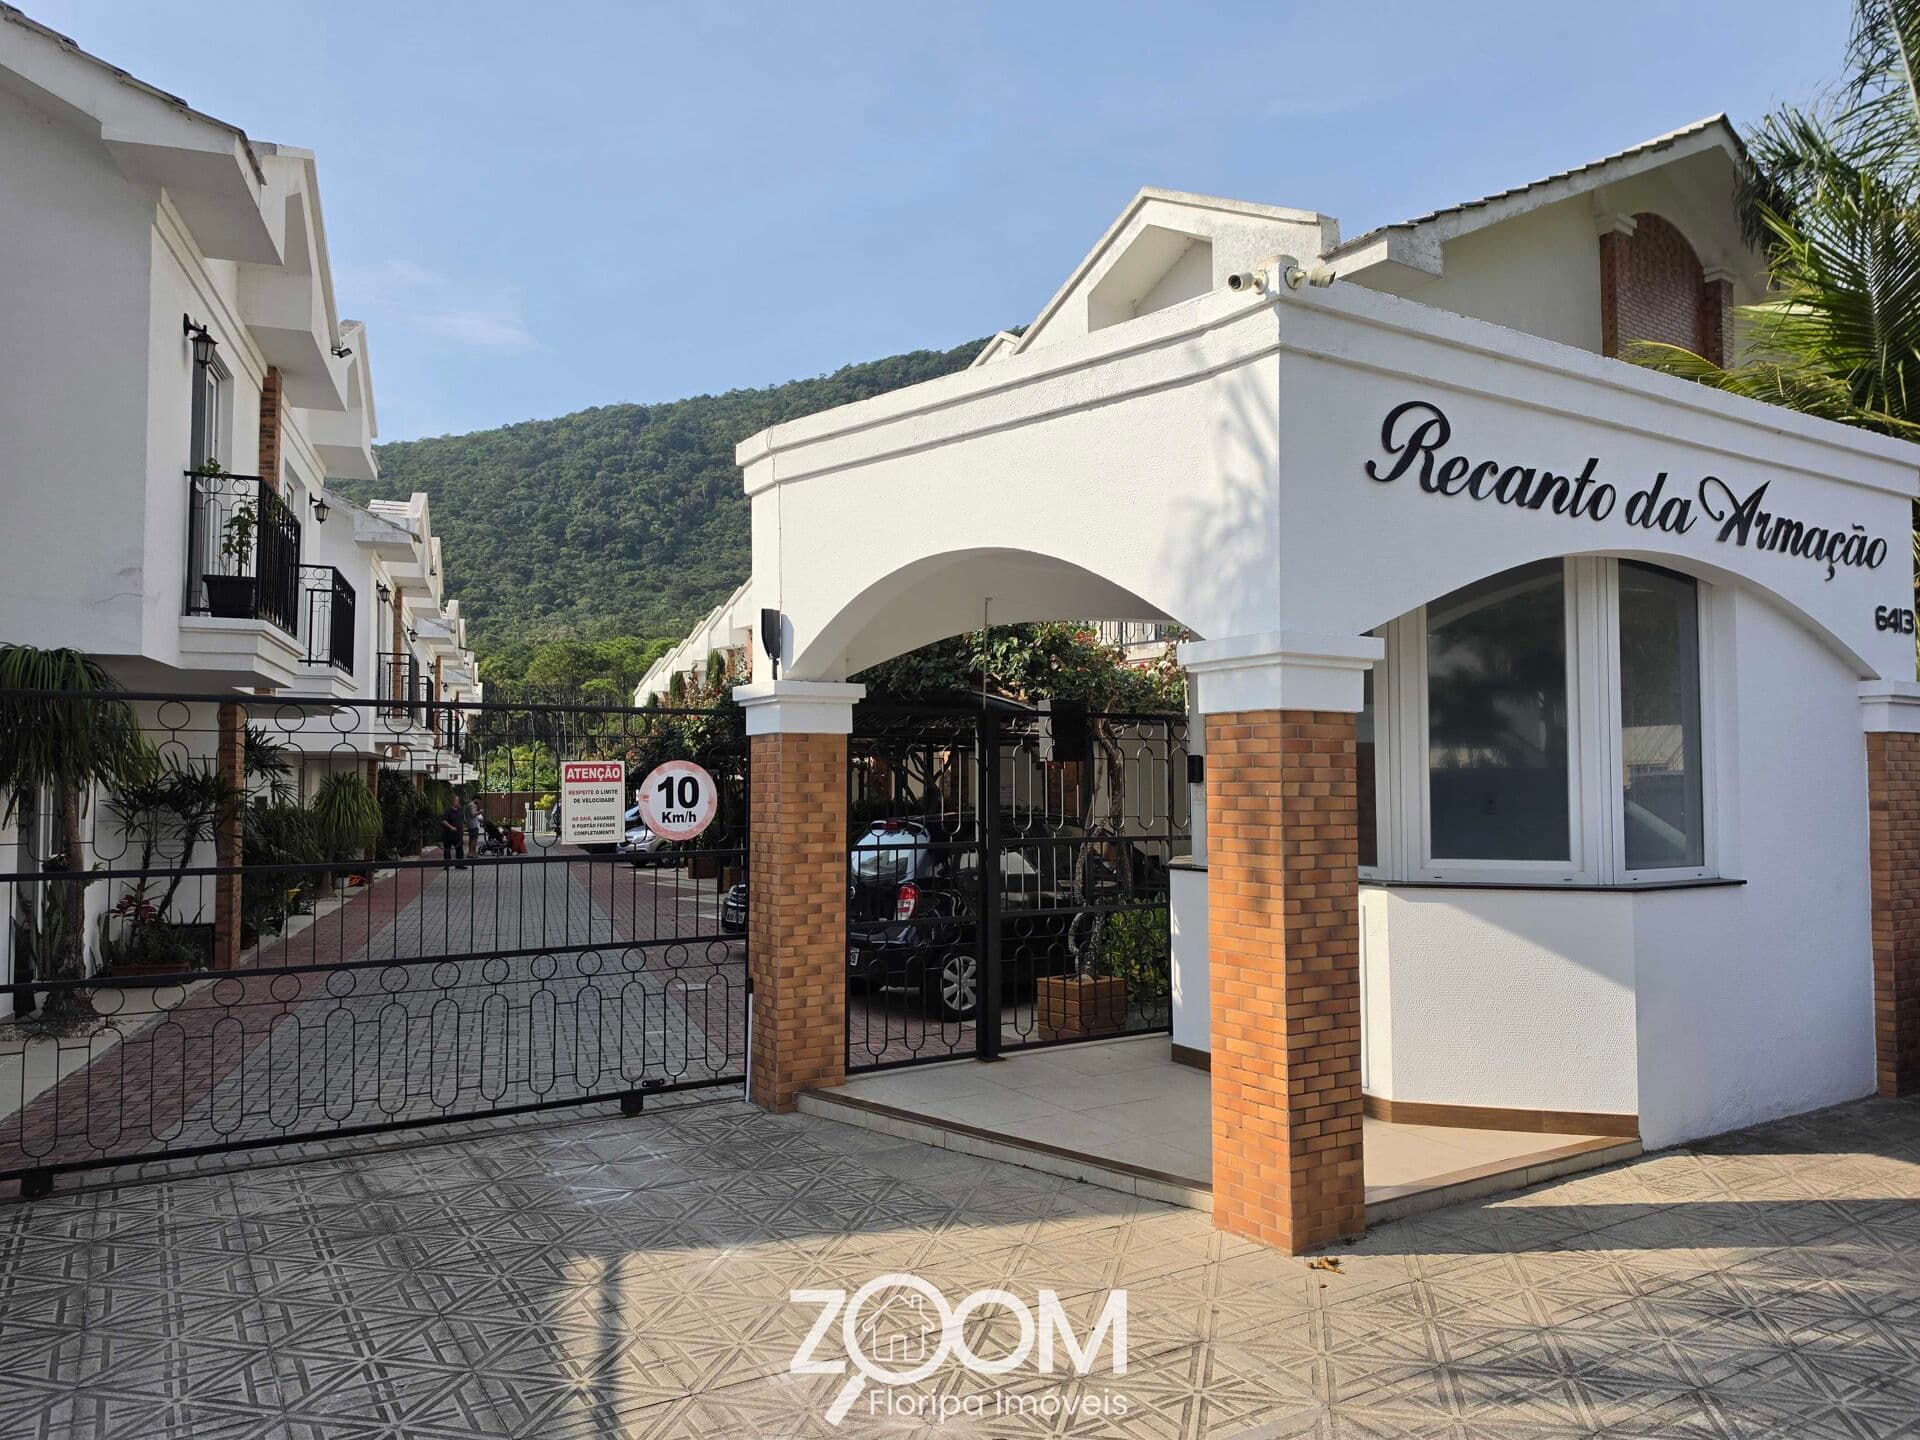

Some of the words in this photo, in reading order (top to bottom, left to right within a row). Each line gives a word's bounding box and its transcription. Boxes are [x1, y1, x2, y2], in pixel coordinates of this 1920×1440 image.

[1365, 400, 1616, 521] Recanto
[1624, 471, 1697, 534] da
[1698, 475, 1888, 581] Armação
[1874, 604, 1914, 635] 6413
[566, 766, 621, 781] ATENÇÃO
[657, 776, 700, 809] 10
[661, 811, 697, 823] Km/h
